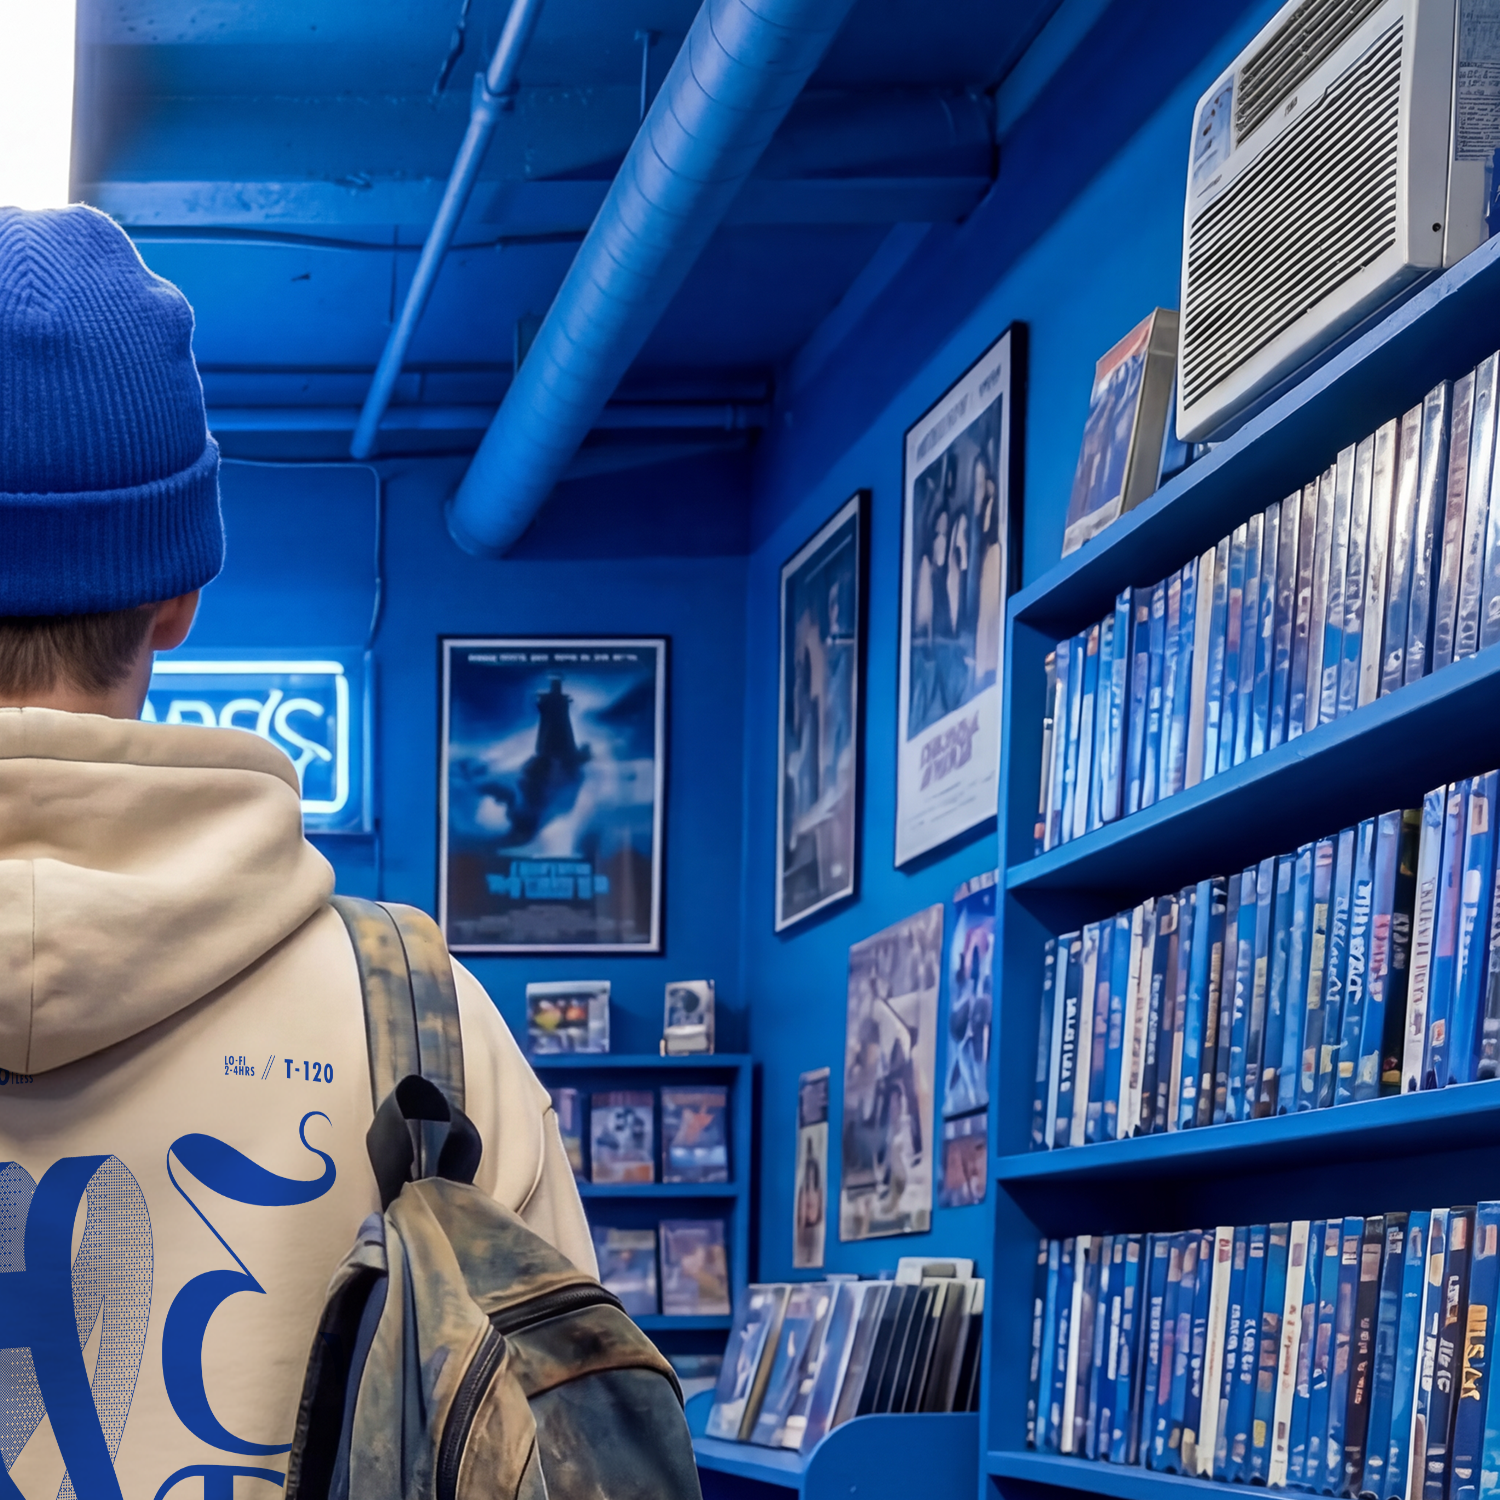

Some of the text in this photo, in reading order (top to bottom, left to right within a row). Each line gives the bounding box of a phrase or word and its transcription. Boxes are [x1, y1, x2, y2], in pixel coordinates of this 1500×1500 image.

[224, 1055, 246, 1066] LO-FI
[224, 1065, 255, 1077] 2-4HRS
[284, 1058, 334, 1084] T-120
